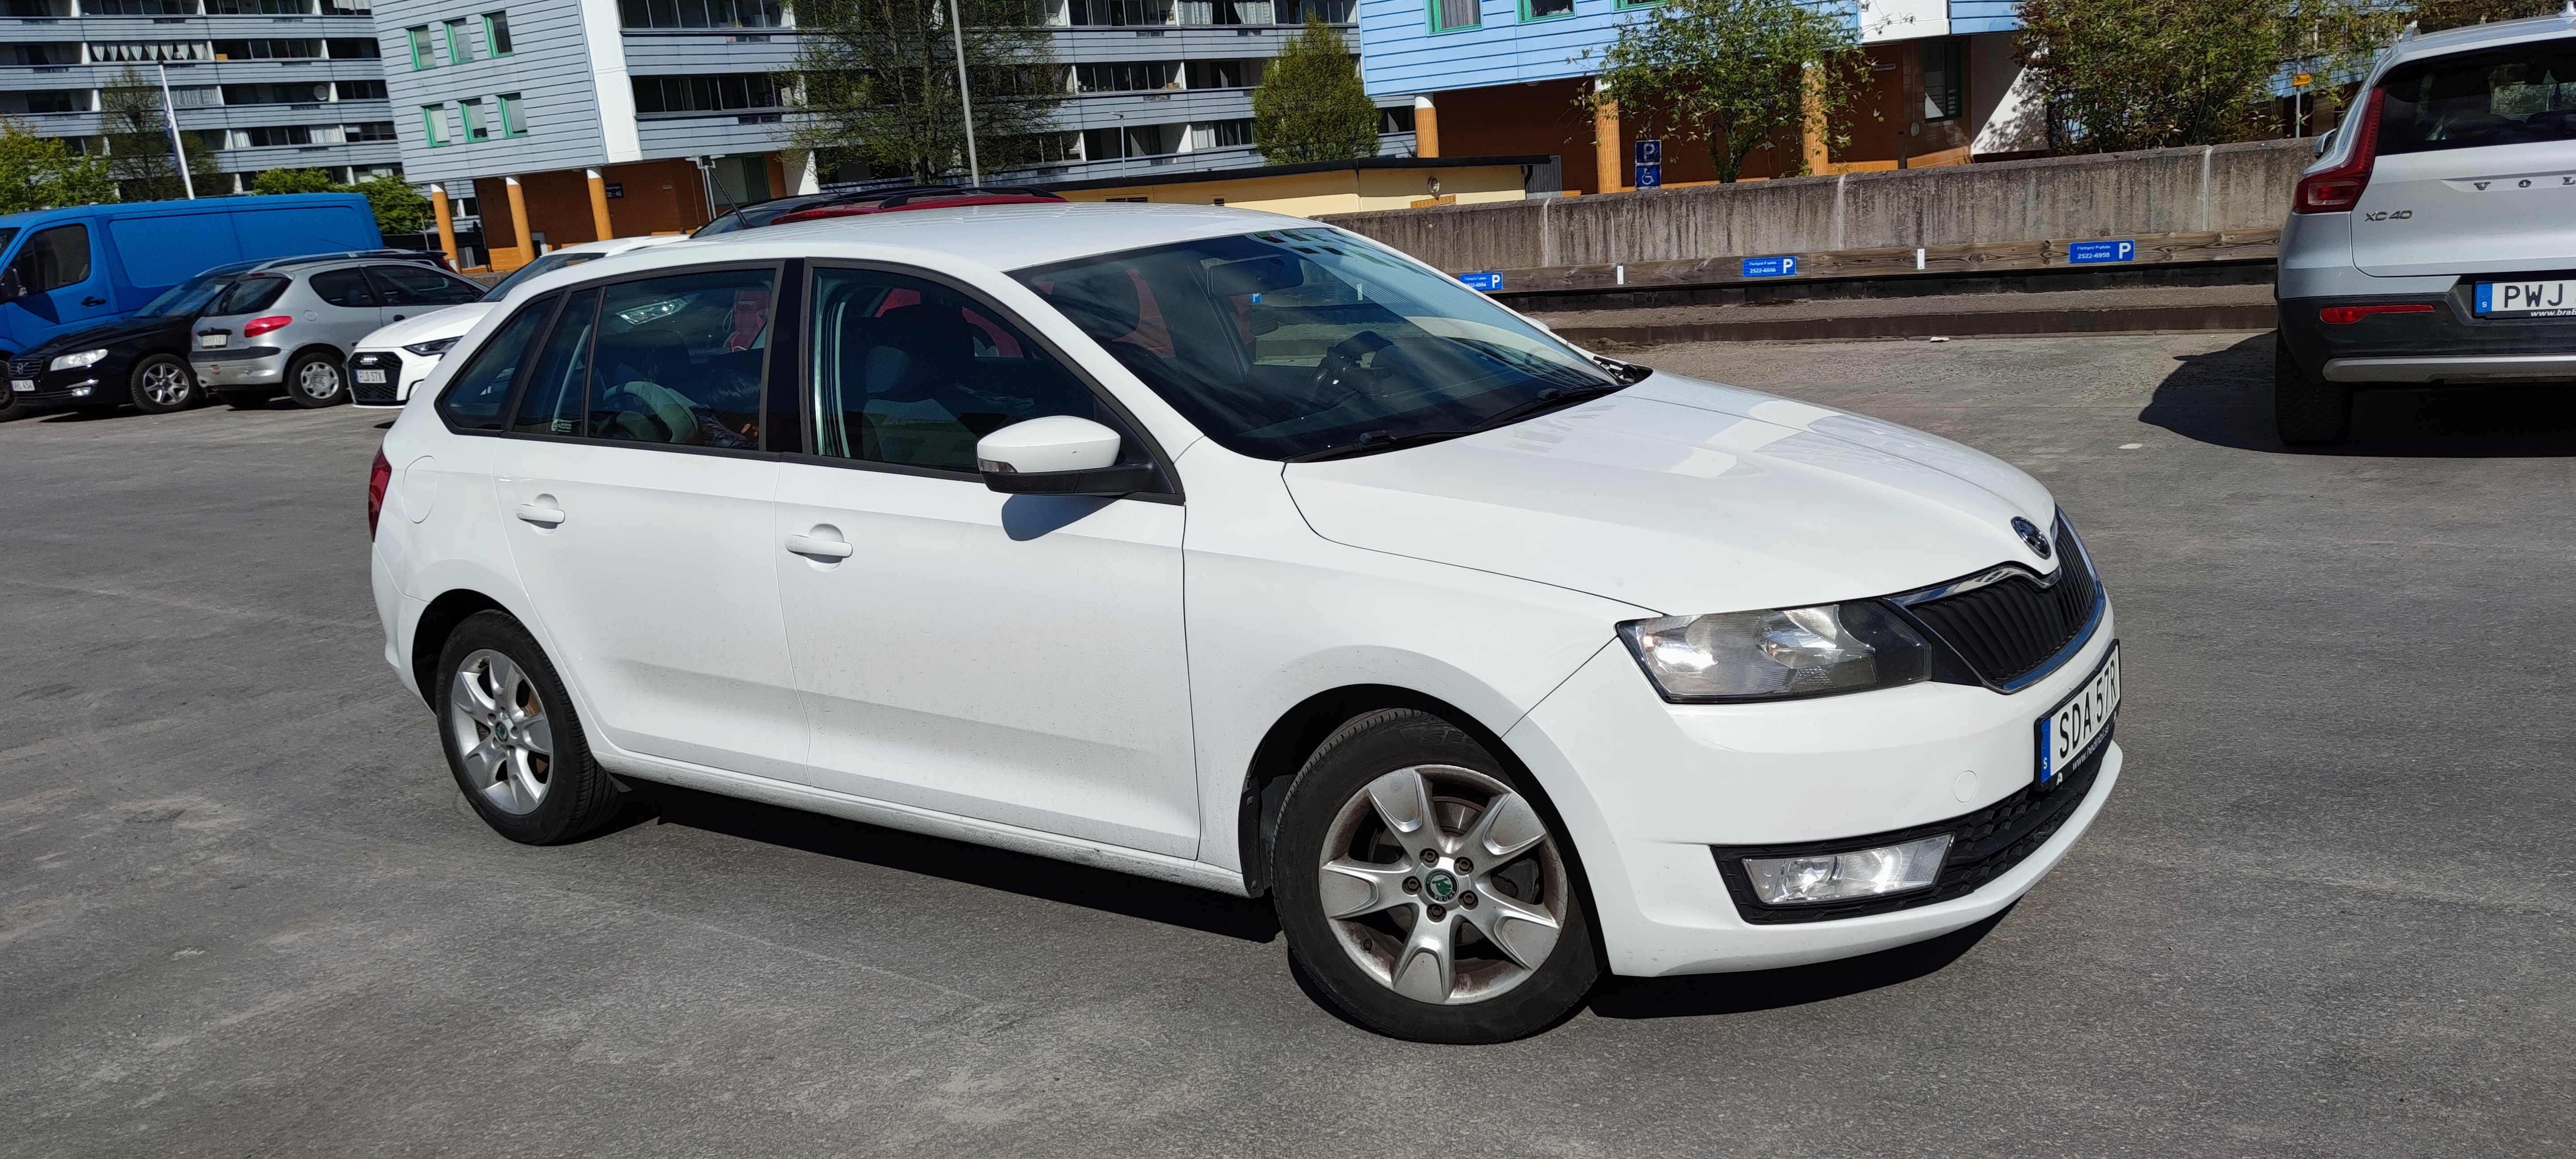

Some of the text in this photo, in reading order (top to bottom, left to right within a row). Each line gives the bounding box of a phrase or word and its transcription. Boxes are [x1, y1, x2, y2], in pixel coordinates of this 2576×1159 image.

[1644, 143, 1655, 161] P
[2119, 242, 2131, 259] P
[1783, 258, 1793, 274] P
[1492, 275, 1500, 288] P
[2043, 659, 2116, 770] S SDA 57R
[2072, 724, 2110, 771] www.hedinbil.se
